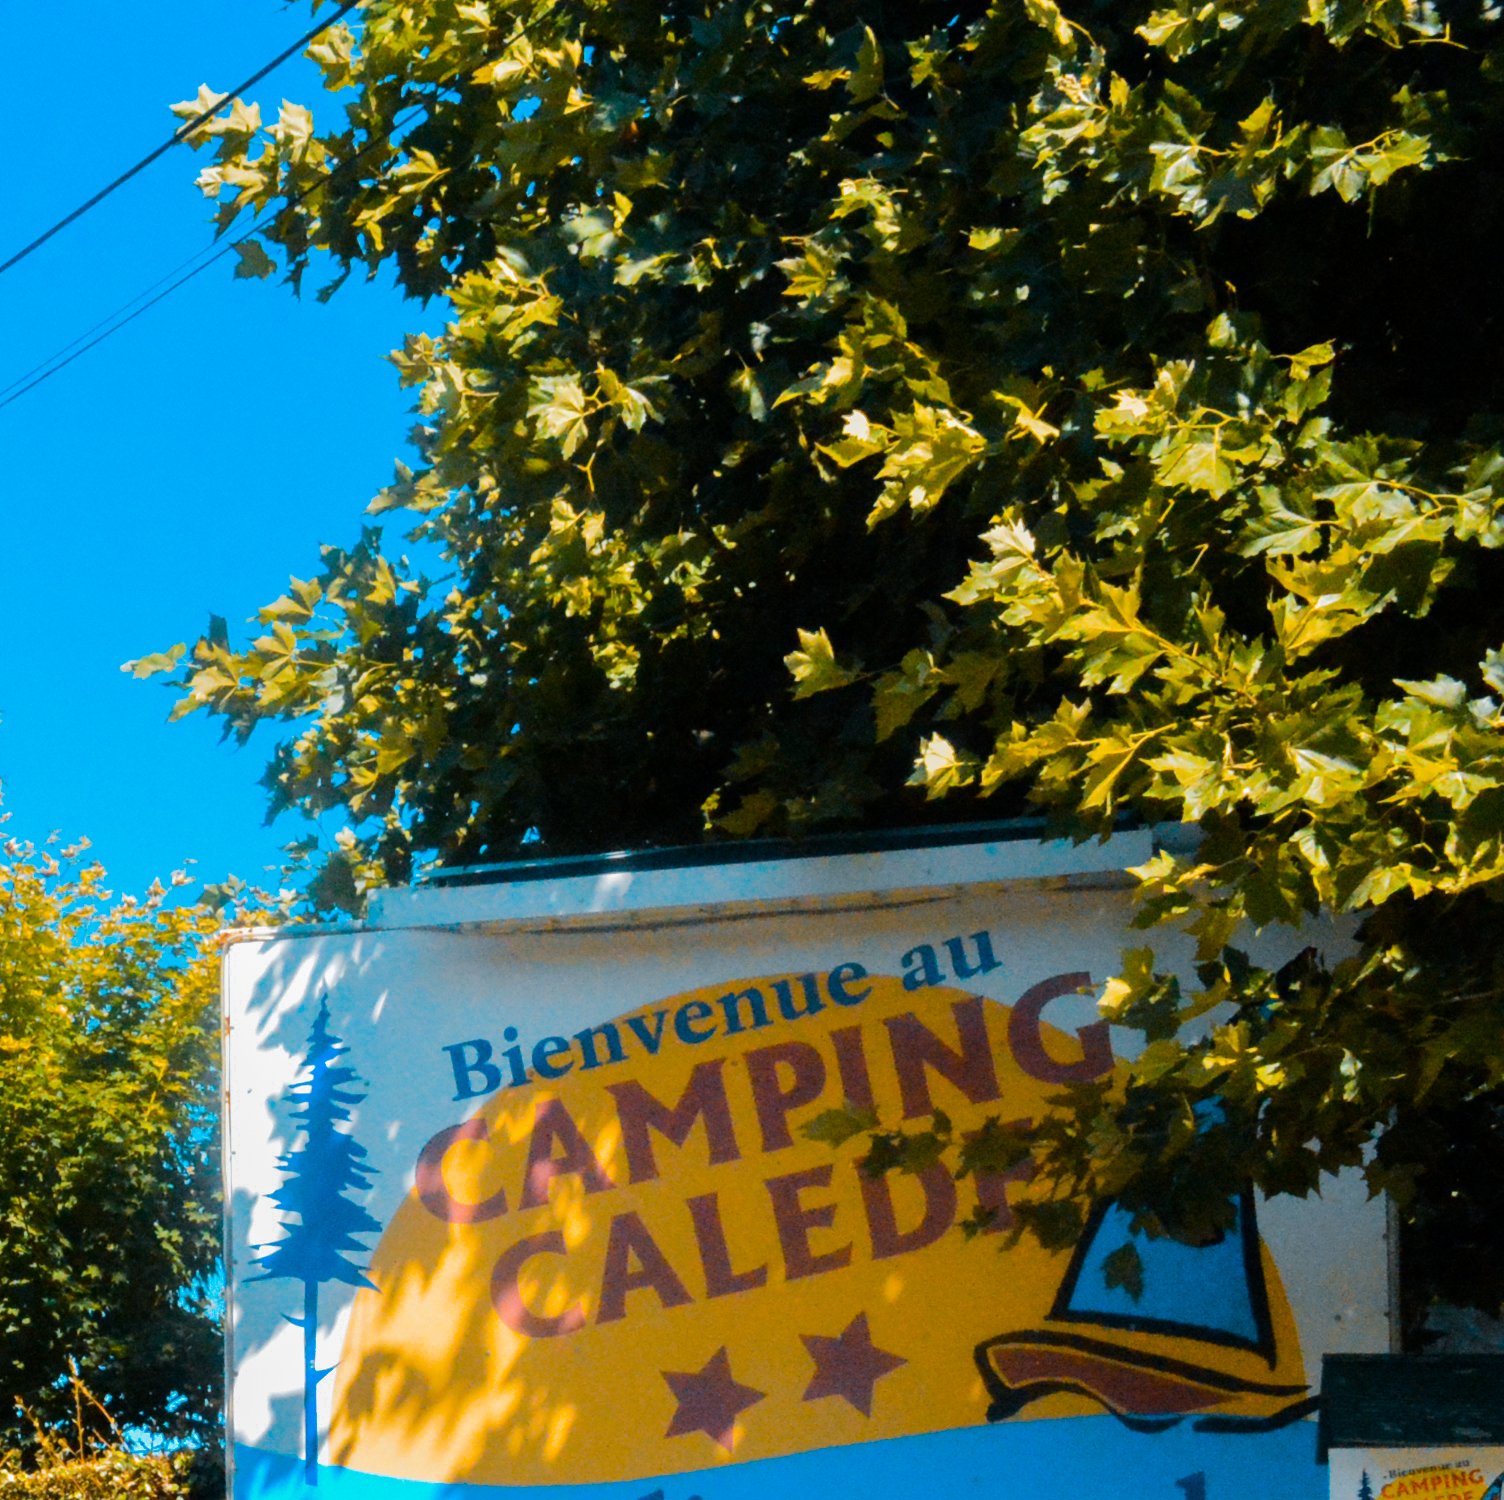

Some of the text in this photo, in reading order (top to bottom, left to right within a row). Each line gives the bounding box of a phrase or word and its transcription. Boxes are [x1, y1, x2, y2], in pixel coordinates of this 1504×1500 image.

[415, 971, 1117, 1225] CAMPING
[442, 929, 1002, 1102] Bienvenue au
[1381, 1469, 1485, 1499] CAMPING
